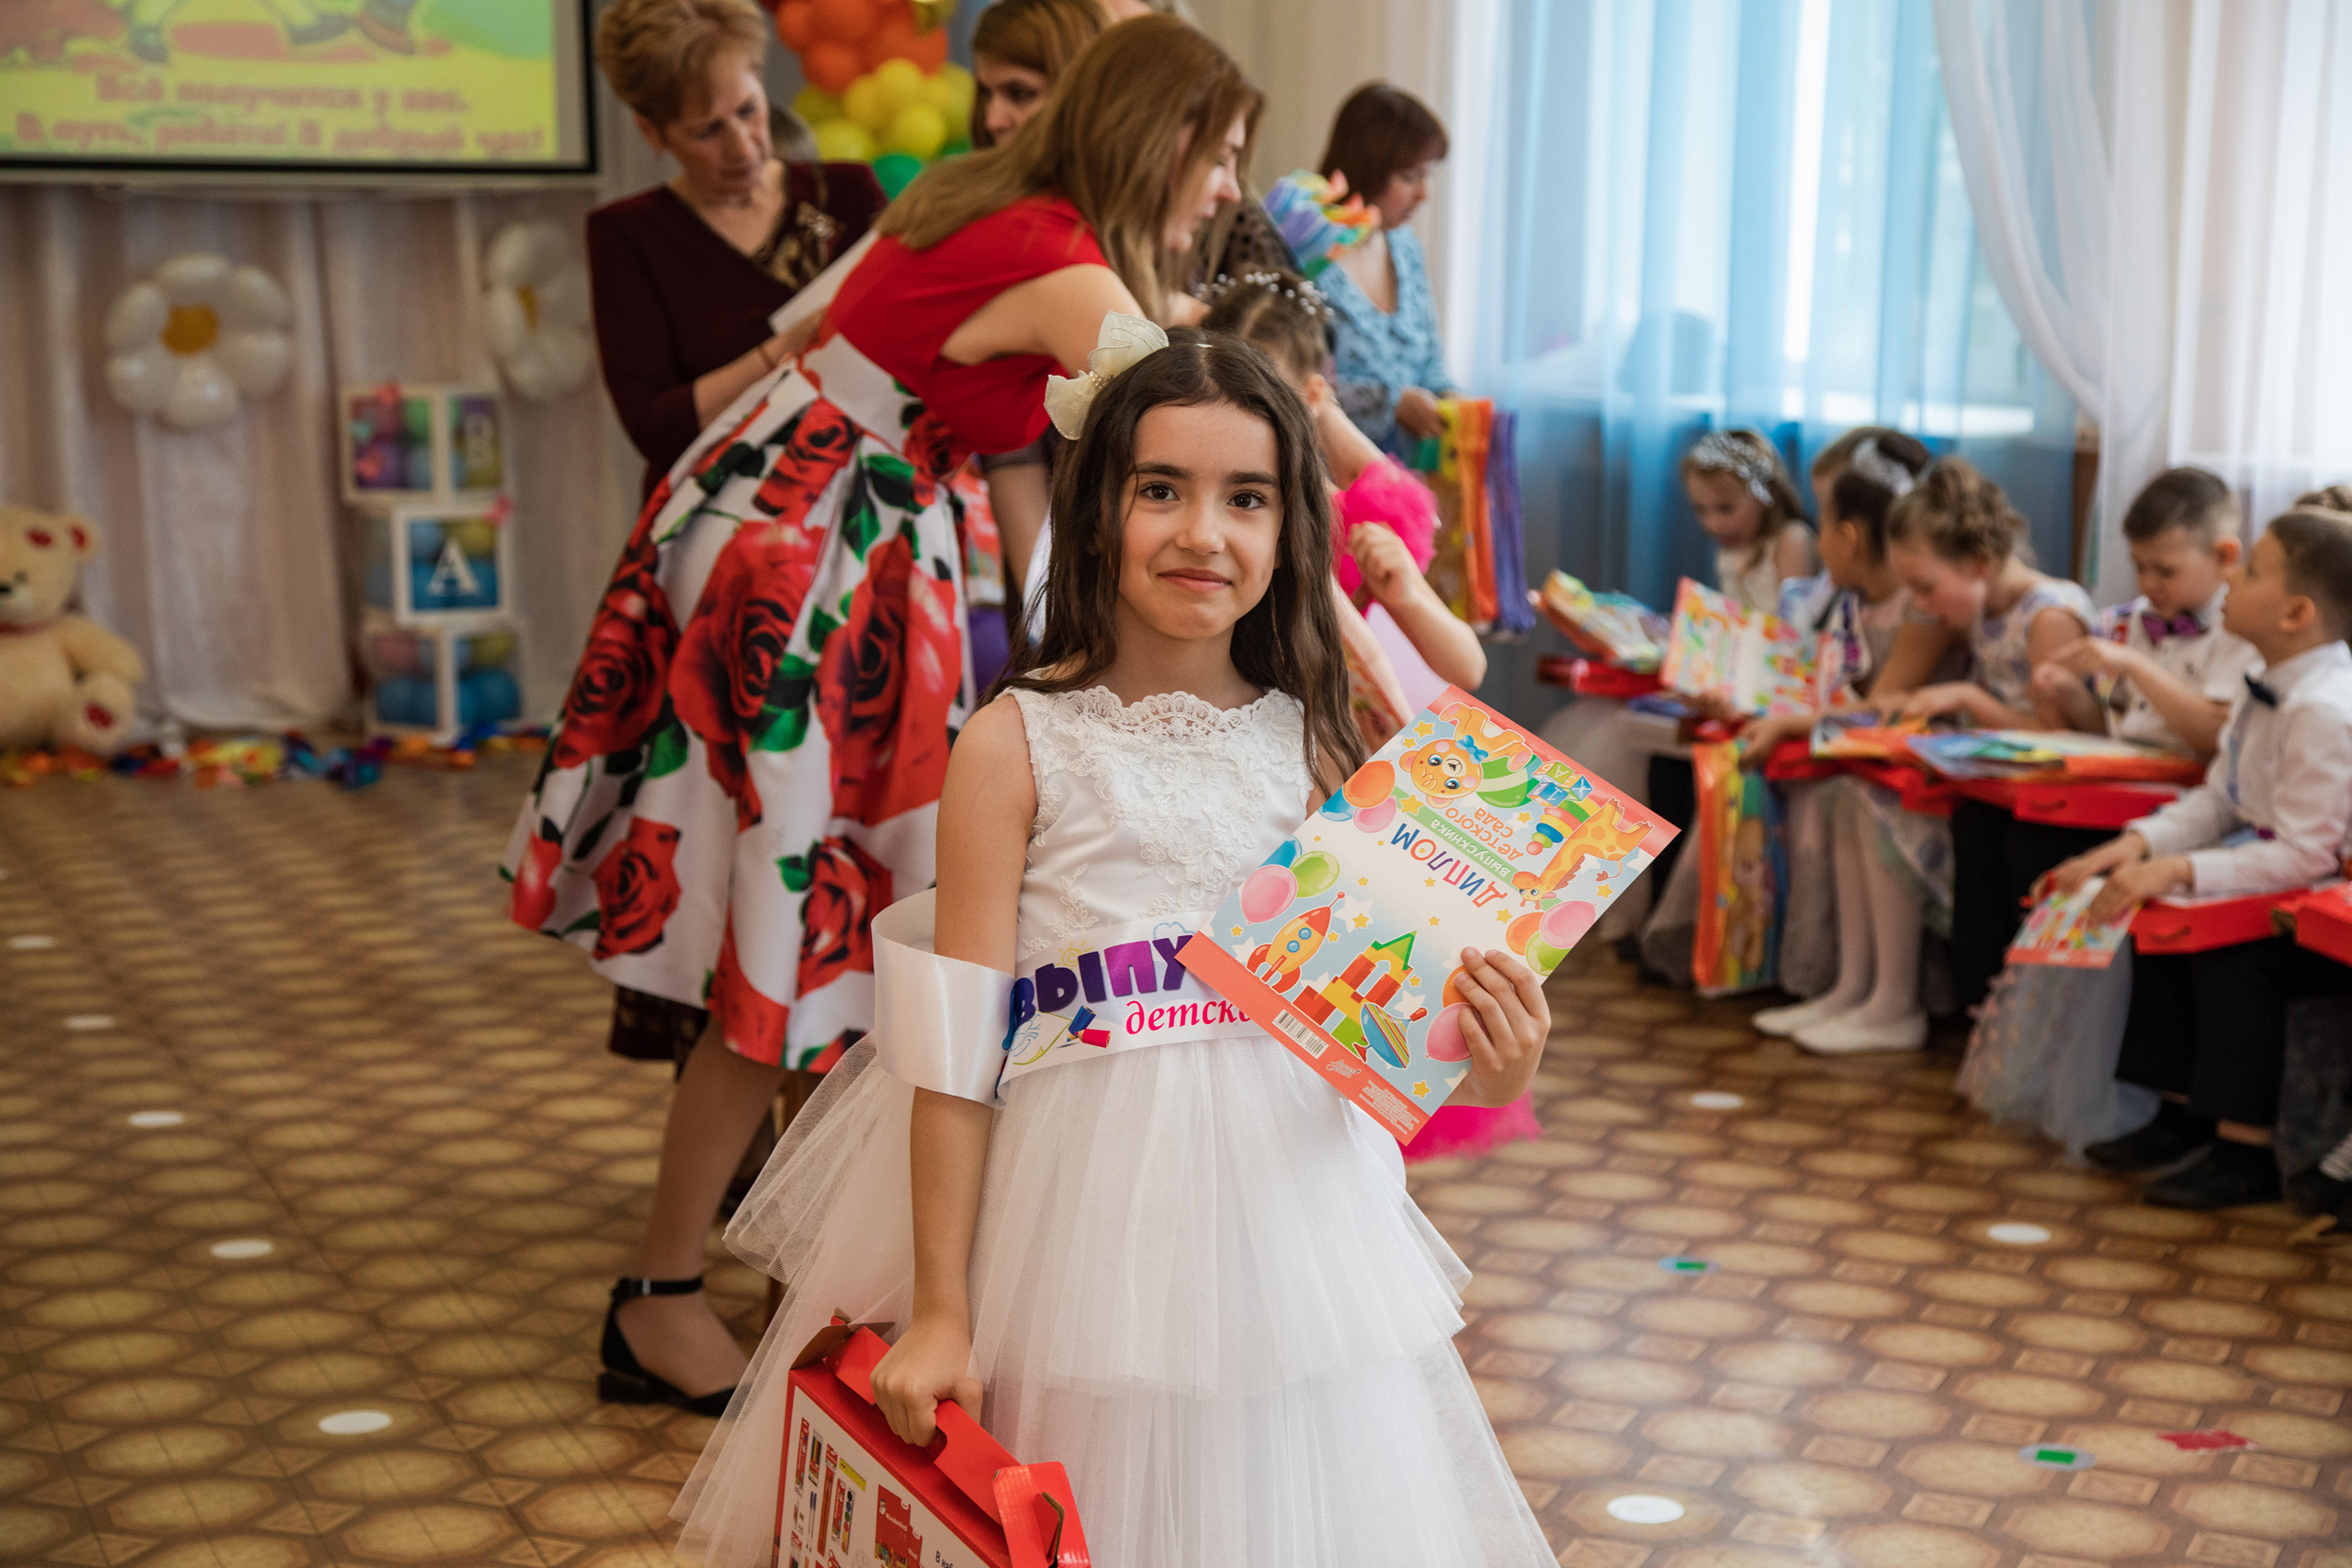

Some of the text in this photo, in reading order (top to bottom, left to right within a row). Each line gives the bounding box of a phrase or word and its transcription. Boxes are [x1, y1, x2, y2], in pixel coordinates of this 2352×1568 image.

[1430, 818, 1510, 878] выпускника
[1445, 807, 1524, 861] детского
[1474, 807, 1513, 838] сада
[1391, 823, 1508, 908] ДИПЛОМ
